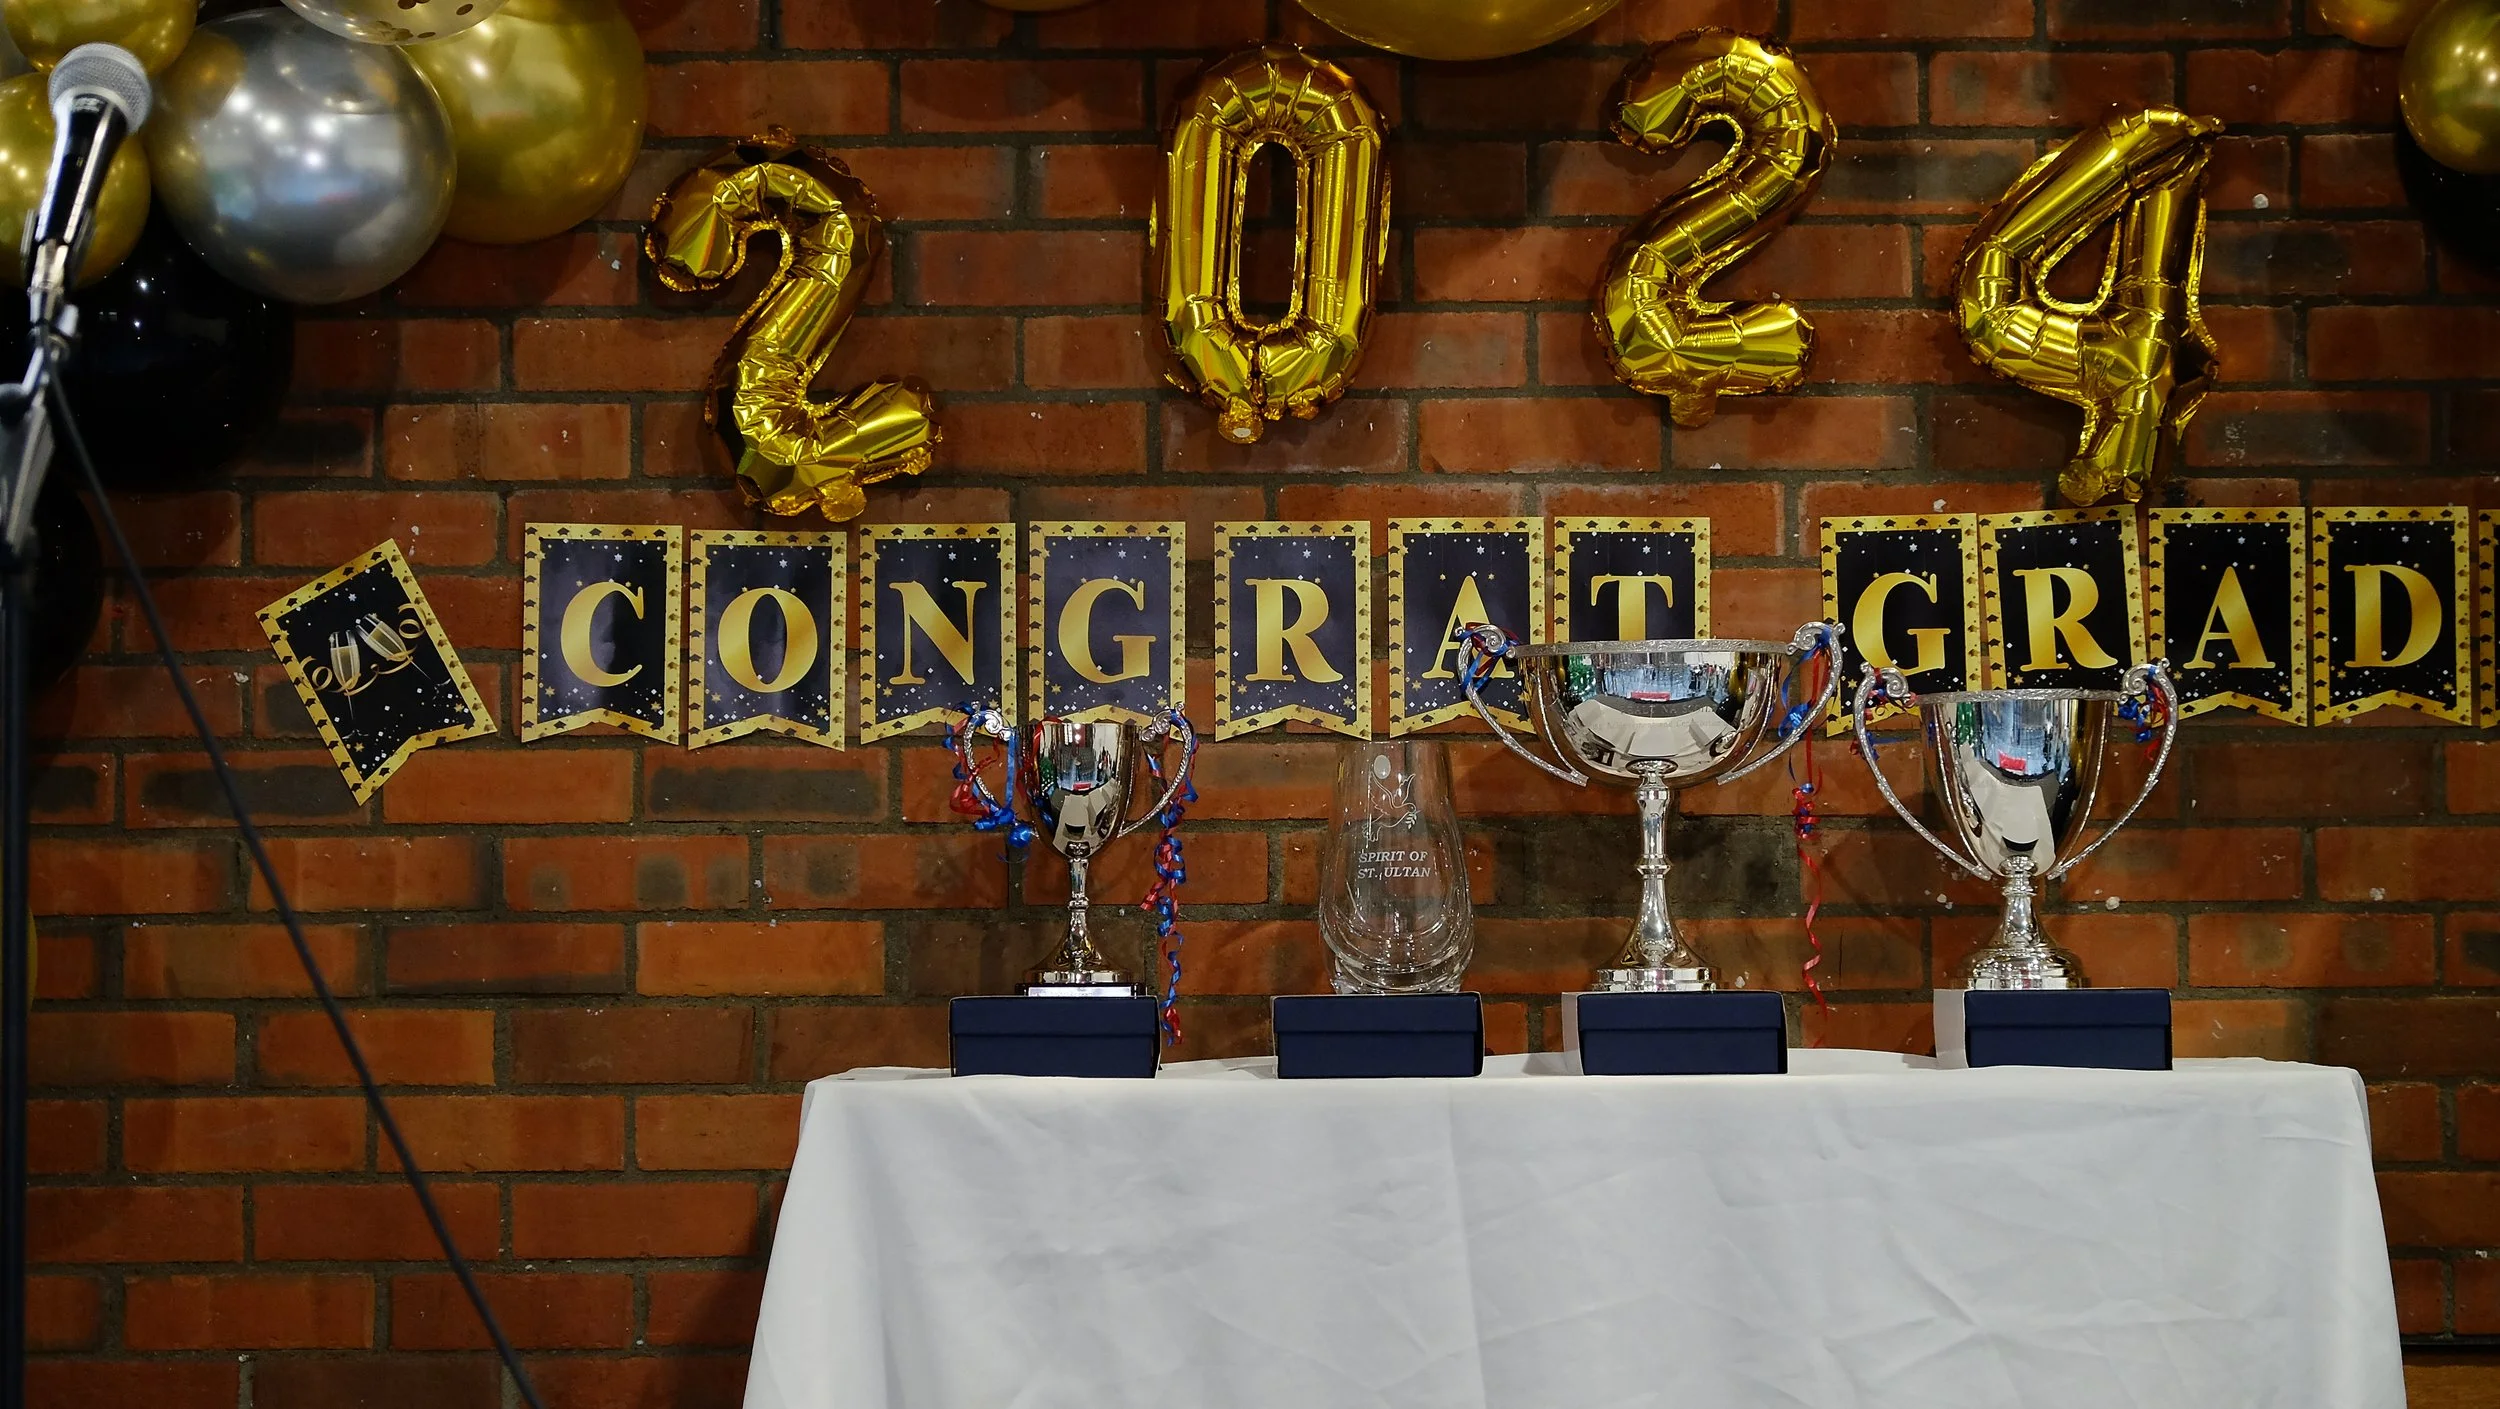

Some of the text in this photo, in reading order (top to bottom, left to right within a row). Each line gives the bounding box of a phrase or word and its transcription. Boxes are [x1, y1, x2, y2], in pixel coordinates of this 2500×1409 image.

[645, 27, 2224, 521] 2024
[561, 564, 2443, 692] CONGRAT GRAD
[1357, 866, 1432, 880] ST. ULTAN
[1358, 850, 1429, 864] SPIRIT OF
